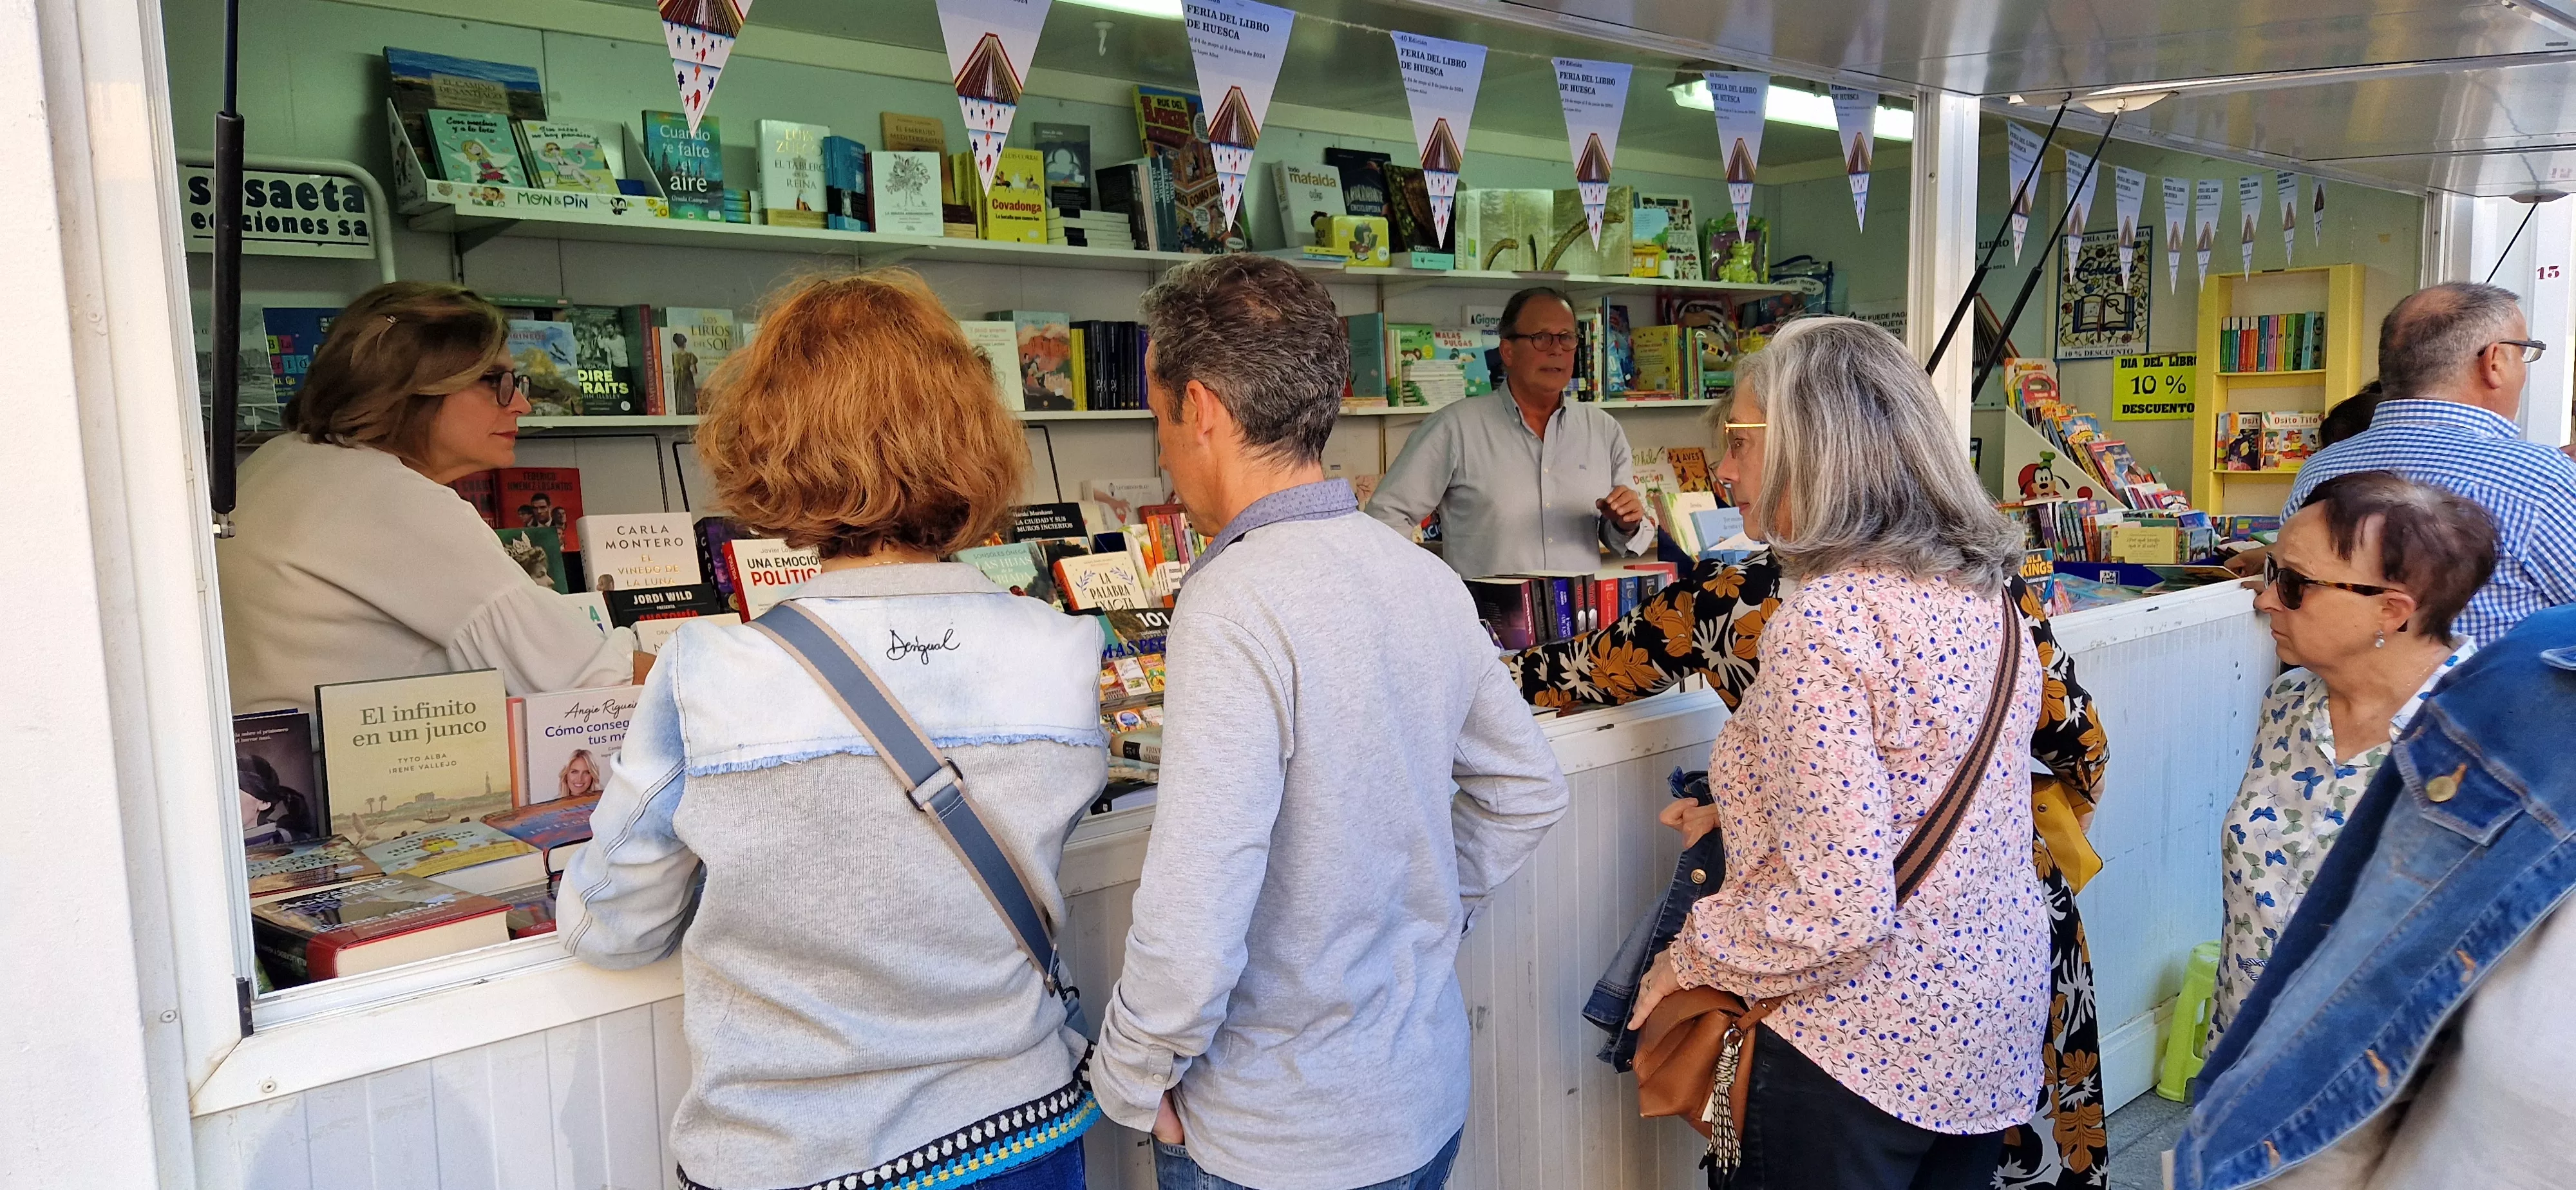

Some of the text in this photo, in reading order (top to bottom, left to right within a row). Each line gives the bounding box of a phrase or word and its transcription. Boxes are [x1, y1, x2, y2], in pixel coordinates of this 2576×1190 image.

[1186, 4, 1270, 33] FERIA DEL LIBRO
[1186, 18, 1240, 40] DE HUESCA
[1401, 48, 1467, 69] FERIA DEL LIBRO
[1401, 61, 1444, 77] DE HUESCA
[1559, 71, 1616, 86] FERIA DEL LIBRO
[1559, 83, 1596, 95] DE HUESCA
[1710, 82, 1757, 95] FERIA DEL LIBRO
[1157, 98, 1185, 111] RUE DEL
[1720, 94, 1741, 104] HUESCA
[678, 141, 710, 158] falte
[681, 158, 692, 171] el
[775, 160, 787, 169] EL
[670, 172, 708, 193] aire
[786, 178, 817, 189] REINA
[1289, 171, 1337, 187] mafalda
[188, 176, 365, 213] ssaeta
[992, 198, 1043, 214] Covadonga
[191, 211, 368, 237] eciones sa
[691, 325, 730, 337] LIRIOS
[1434, 332, 1461, 340] MALAS
[706, 338, 732, 351] SOL
[2121, 357, 2138, 368] DIA
[2143, 357, 2163, 368] DEL
[578, 370, 612, 382] DIRE
[578, 382, 629, 395] TRAITS
[2130, 374, 2186, 395] 10 %
[2122, 403, 2195, 414] DESCUENTO
[2274, 416, 2318, 425] Osito Tito
[1682, 453, 1700, 461] AVES
[1017, 522, 1074, 533] MUROS INCIERTOS
[1025, 517, 1048, 525] CIUDAD
[617, 525, 669, 536] CARLA
[605, 537, 683, 549] MONTERO
[641, 554, 654, 563] EL
[747, 554, 819, 569] UNA EMOCIÓ
[973, 551, 1005, 560] SONSOLES
[665, 565, 679, 573] DE
[975, 556, 1033, 571] LAS HIJAS
[645, 578, 676, 586] LUNA
[751, 567, 817, 587] POLÍTIC
[1099, 572, 1112, 585] LA
[633, 590, 693, 605] JORDI WILD
[1090, 584, 1132, 600] PALABRA
[1095, 598, 1136, 611] EXACTA
[1136, 612, 1170, 628] 101
[886, 628, 961, 665] Desigual
[360, 699, 477, 726] El infinito
[565, 699, 638, 722] Angie Rigueir
[352, 720, 487, 747] en un junco
[545, 720, 630, 737] Cómo conseg
[588, 735, 607, 745] tus
[389, 760, 457, 774] IRENE VALLEJO
